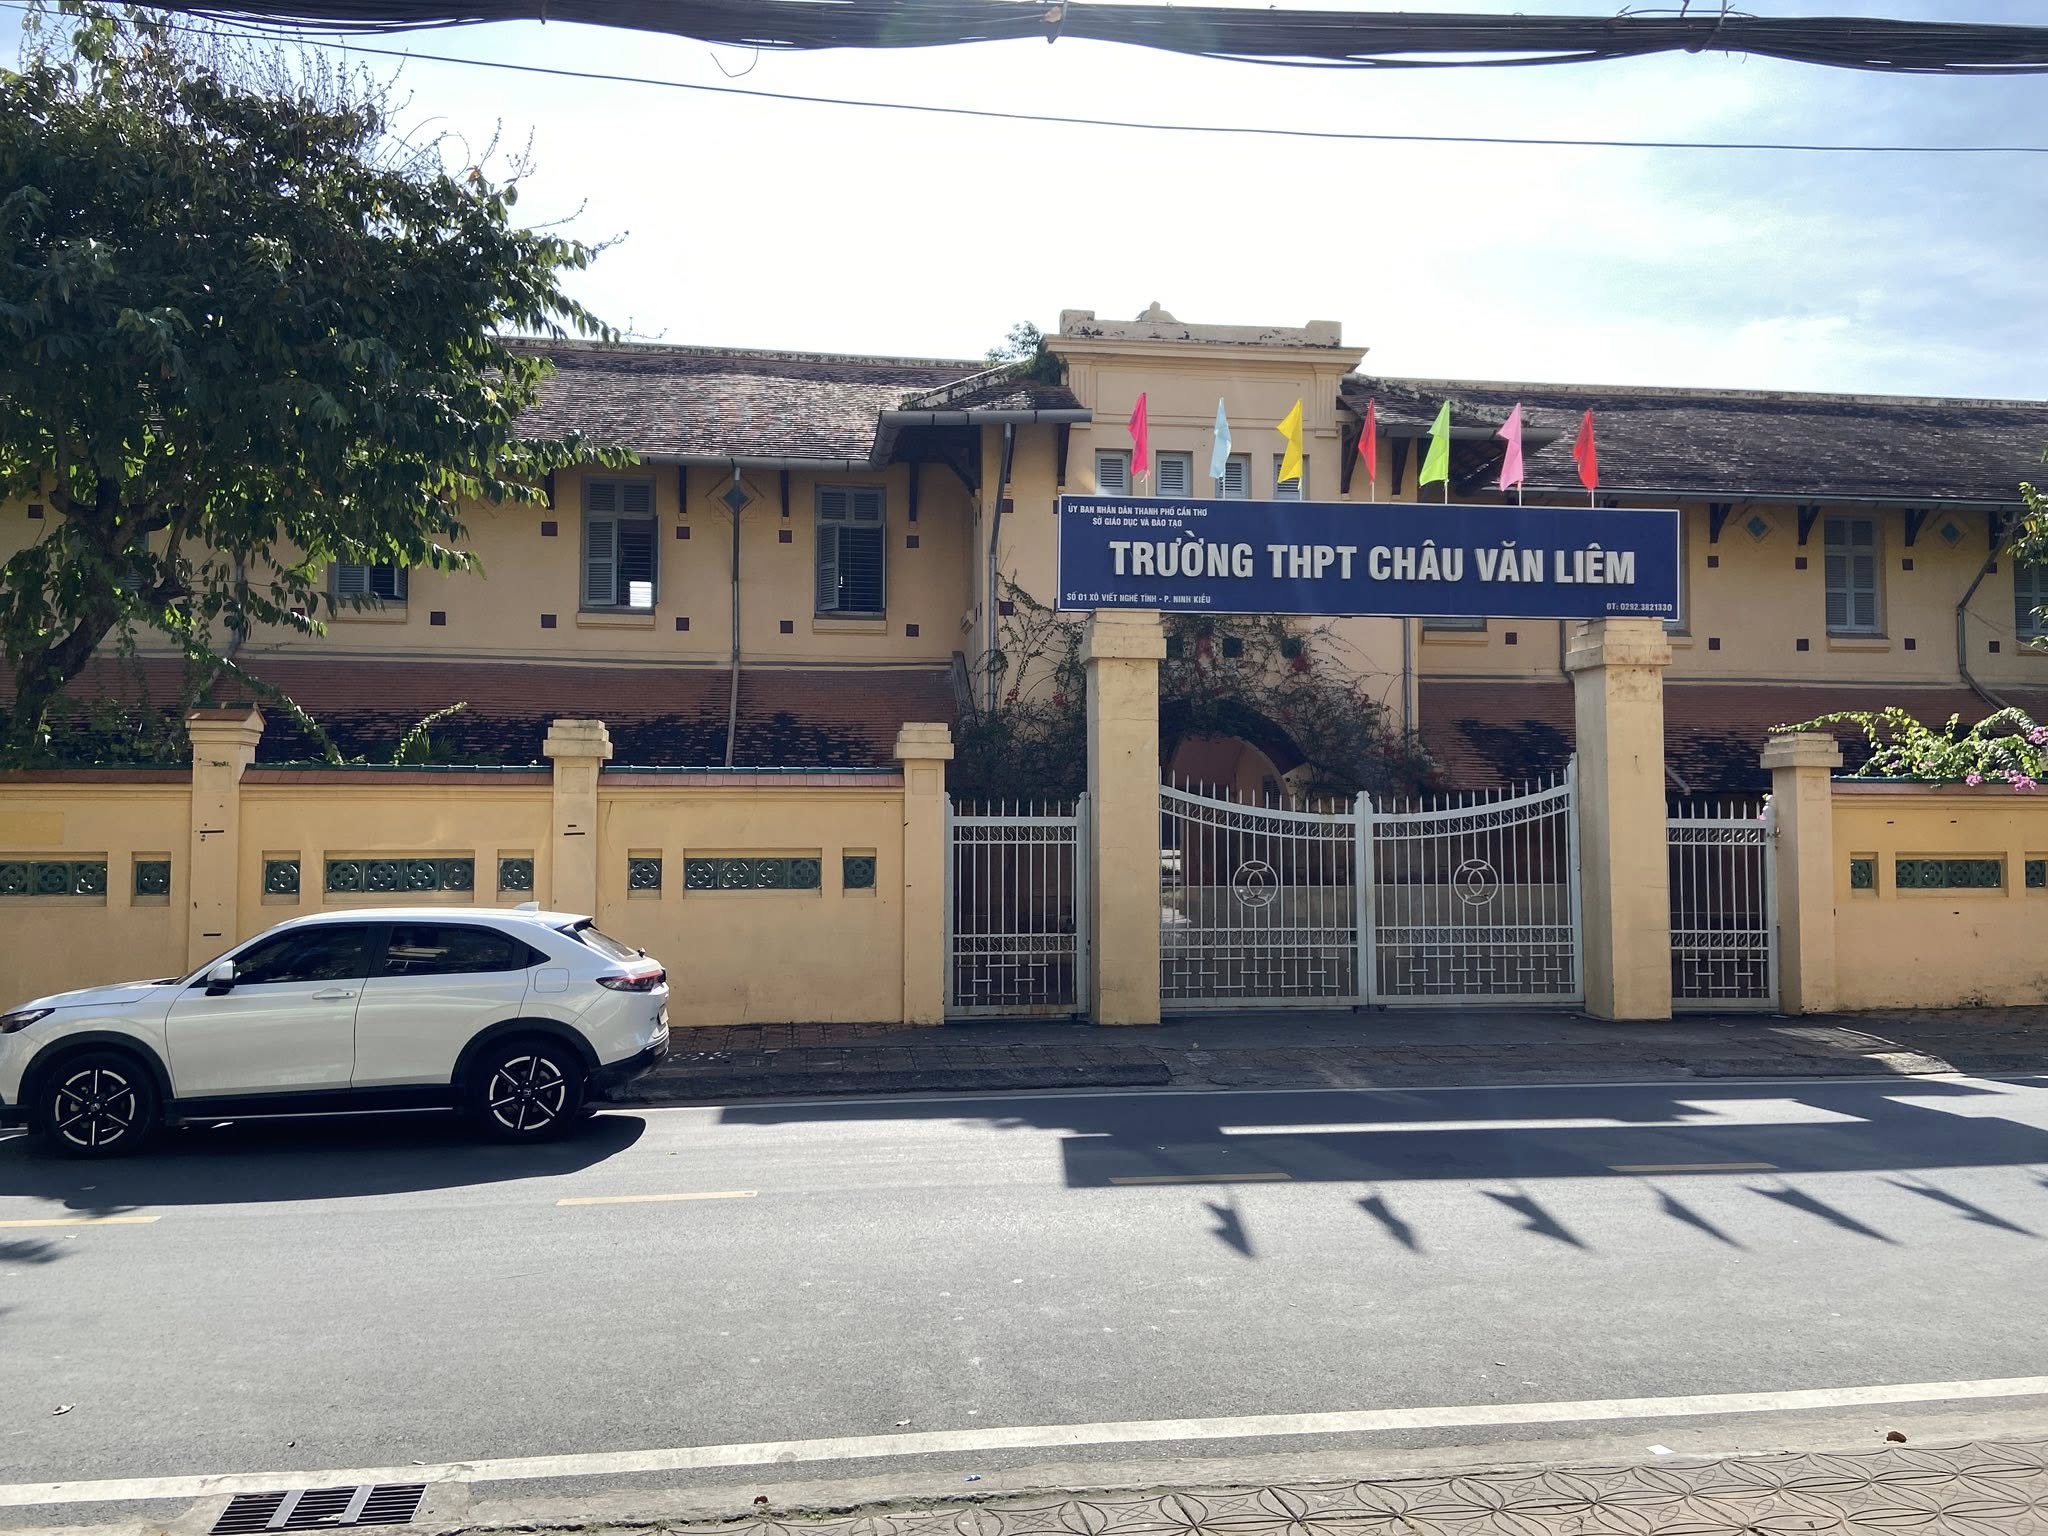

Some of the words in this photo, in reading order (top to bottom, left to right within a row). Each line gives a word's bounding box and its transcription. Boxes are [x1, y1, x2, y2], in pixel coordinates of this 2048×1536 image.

[1080, 505, 1094, 513] BAN
[1097, 504, 1116, 514] NHÂN
[1118, 505, 1132, 514] DÂN
[1160, 505, 1175, 516] PHỐ
[1193, 507, 1207, 517] THƠ
[1104, 517, 1121, 526] GIÁO
[1123, 518, 1138, 528] DỤC
[1140, 517, 1149, 526] VÀ
[1168, 519, 1182, 529] TẠO
[1109, 530, 1253, 578] TRƯỜNG
[1267, 544, 1357, 579] THPT
[1369, 539, 1463, 582] CHÂU
[1476, 540, 1544, 583] VĂN
[1554, 543, 1635, 585] LIÊM
[1066, 591, 1077, 601] SỐ
[1089, 591, 1099, 602] XÔ
[1102, 592, 1117, 602] VIẾT
[1173, 596, 1191, 604] NINH
